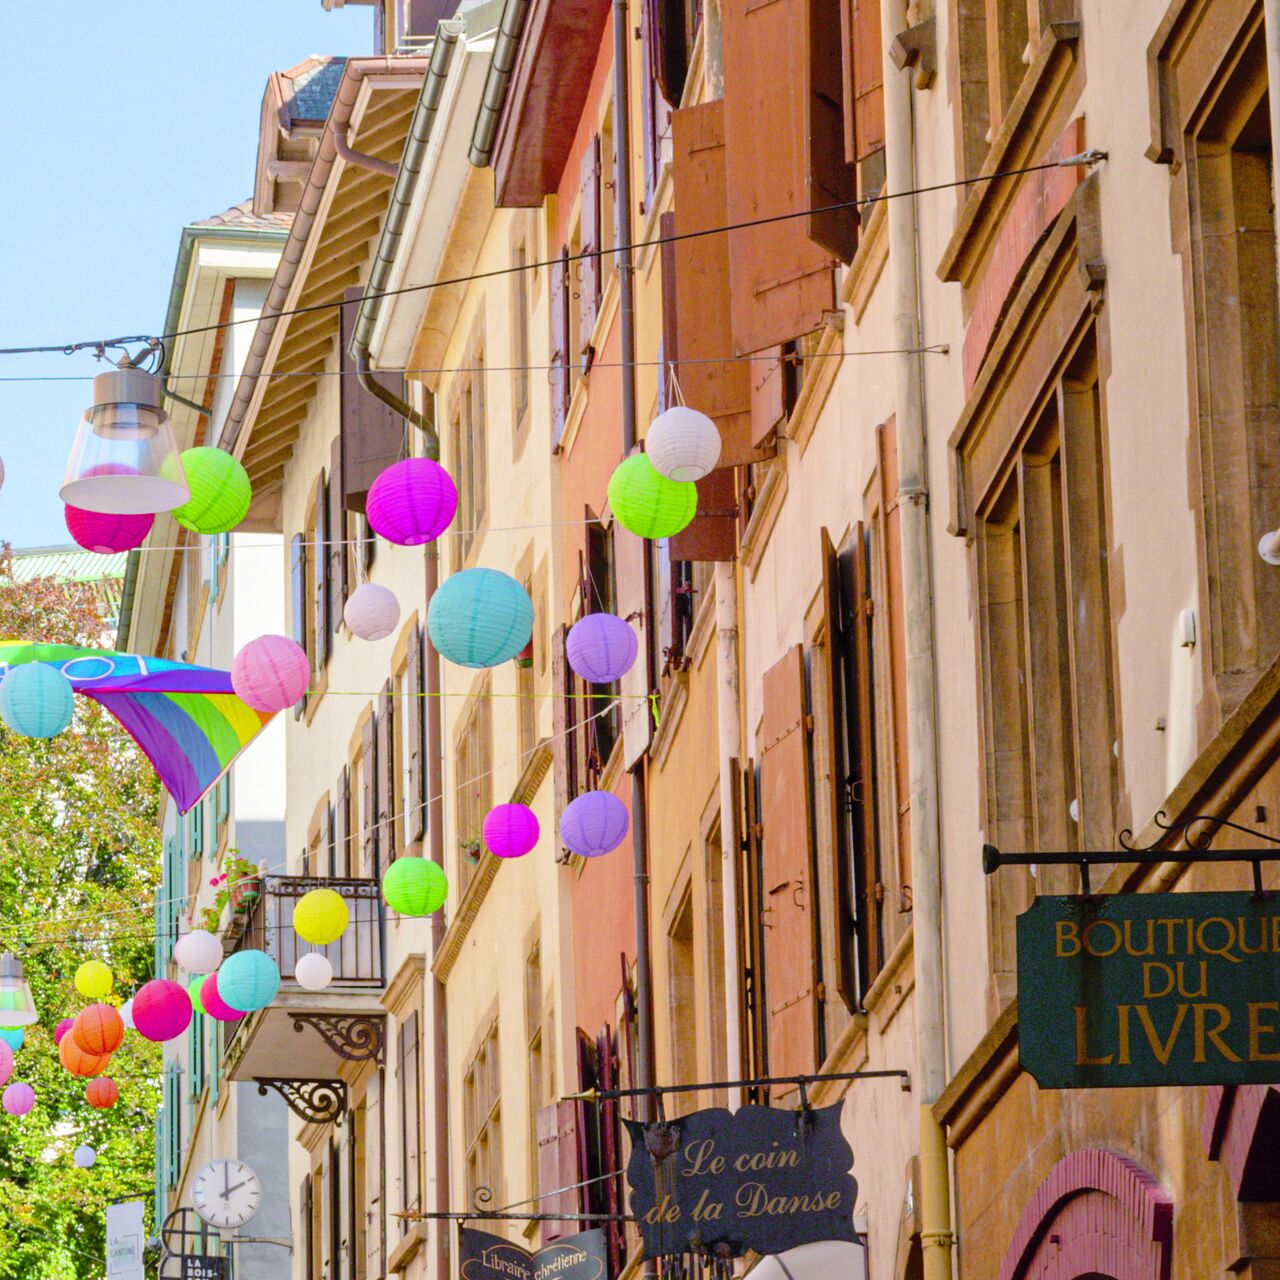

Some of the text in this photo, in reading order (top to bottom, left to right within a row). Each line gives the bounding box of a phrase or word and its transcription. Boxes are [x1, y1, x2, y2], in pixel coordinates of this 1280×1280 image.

[1142, 960, 1208, 999] DU
[682, 1139, 801, 1177] Le coin
[642, 1181, 843, 1225] de la Danse
[187, 1258, 201, 1268] LA
[187, 1268, 218, 1279] BOIS-
